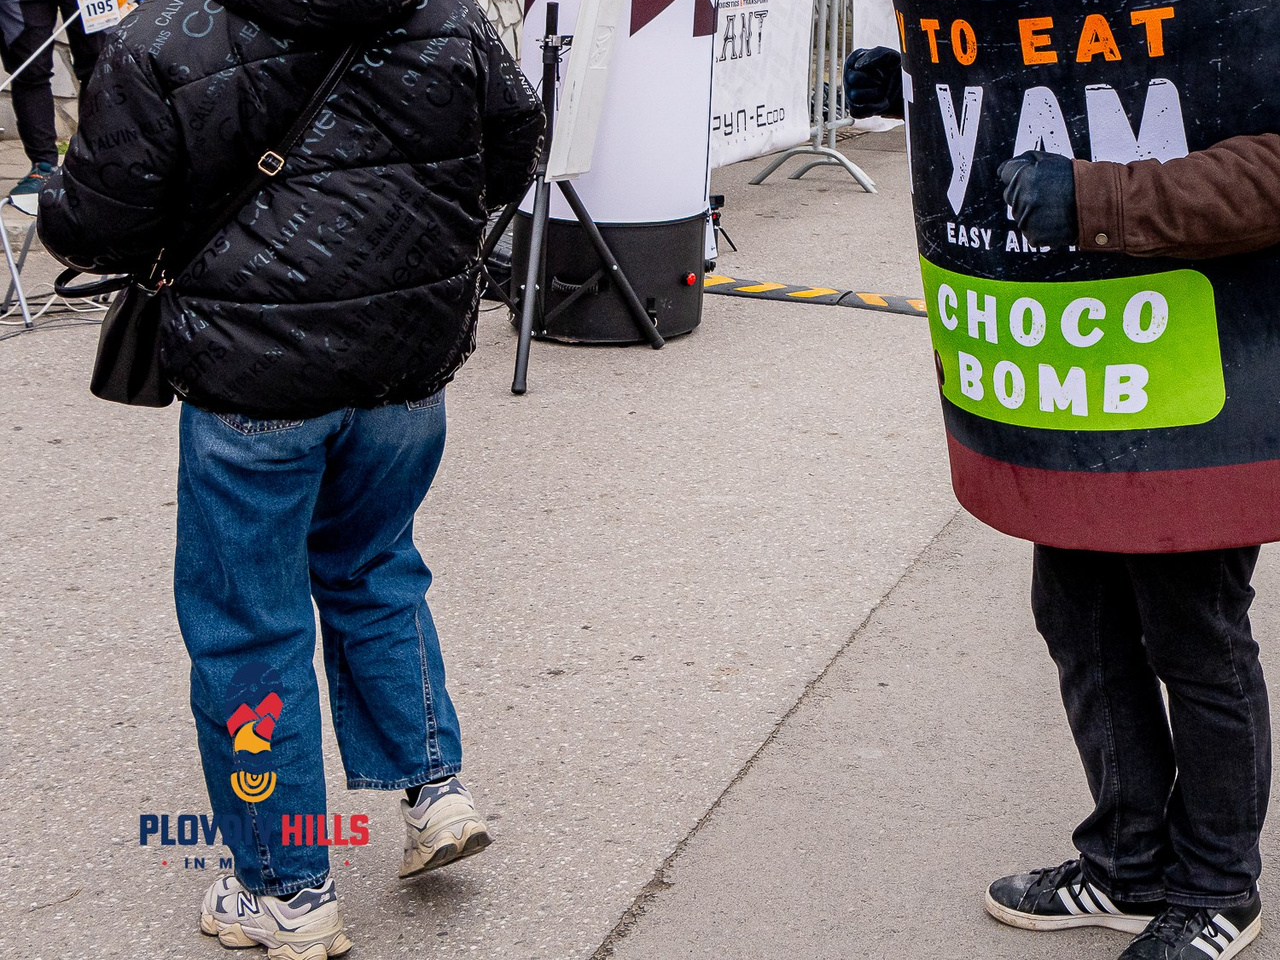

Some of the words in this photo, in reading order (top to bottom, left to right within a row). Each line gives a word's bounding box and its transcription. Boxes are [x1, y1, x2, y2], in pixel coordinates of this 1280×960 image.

[920, 19, 977, 65] TO
[1018, 6, 1175, 65] EAT
[936, 78, 1189, 219] YAM
[947, 222, 992, 250] EASY
[937, 283, 1169, 348] CHOCO
[957, 350, 1150, 417] BOMB
